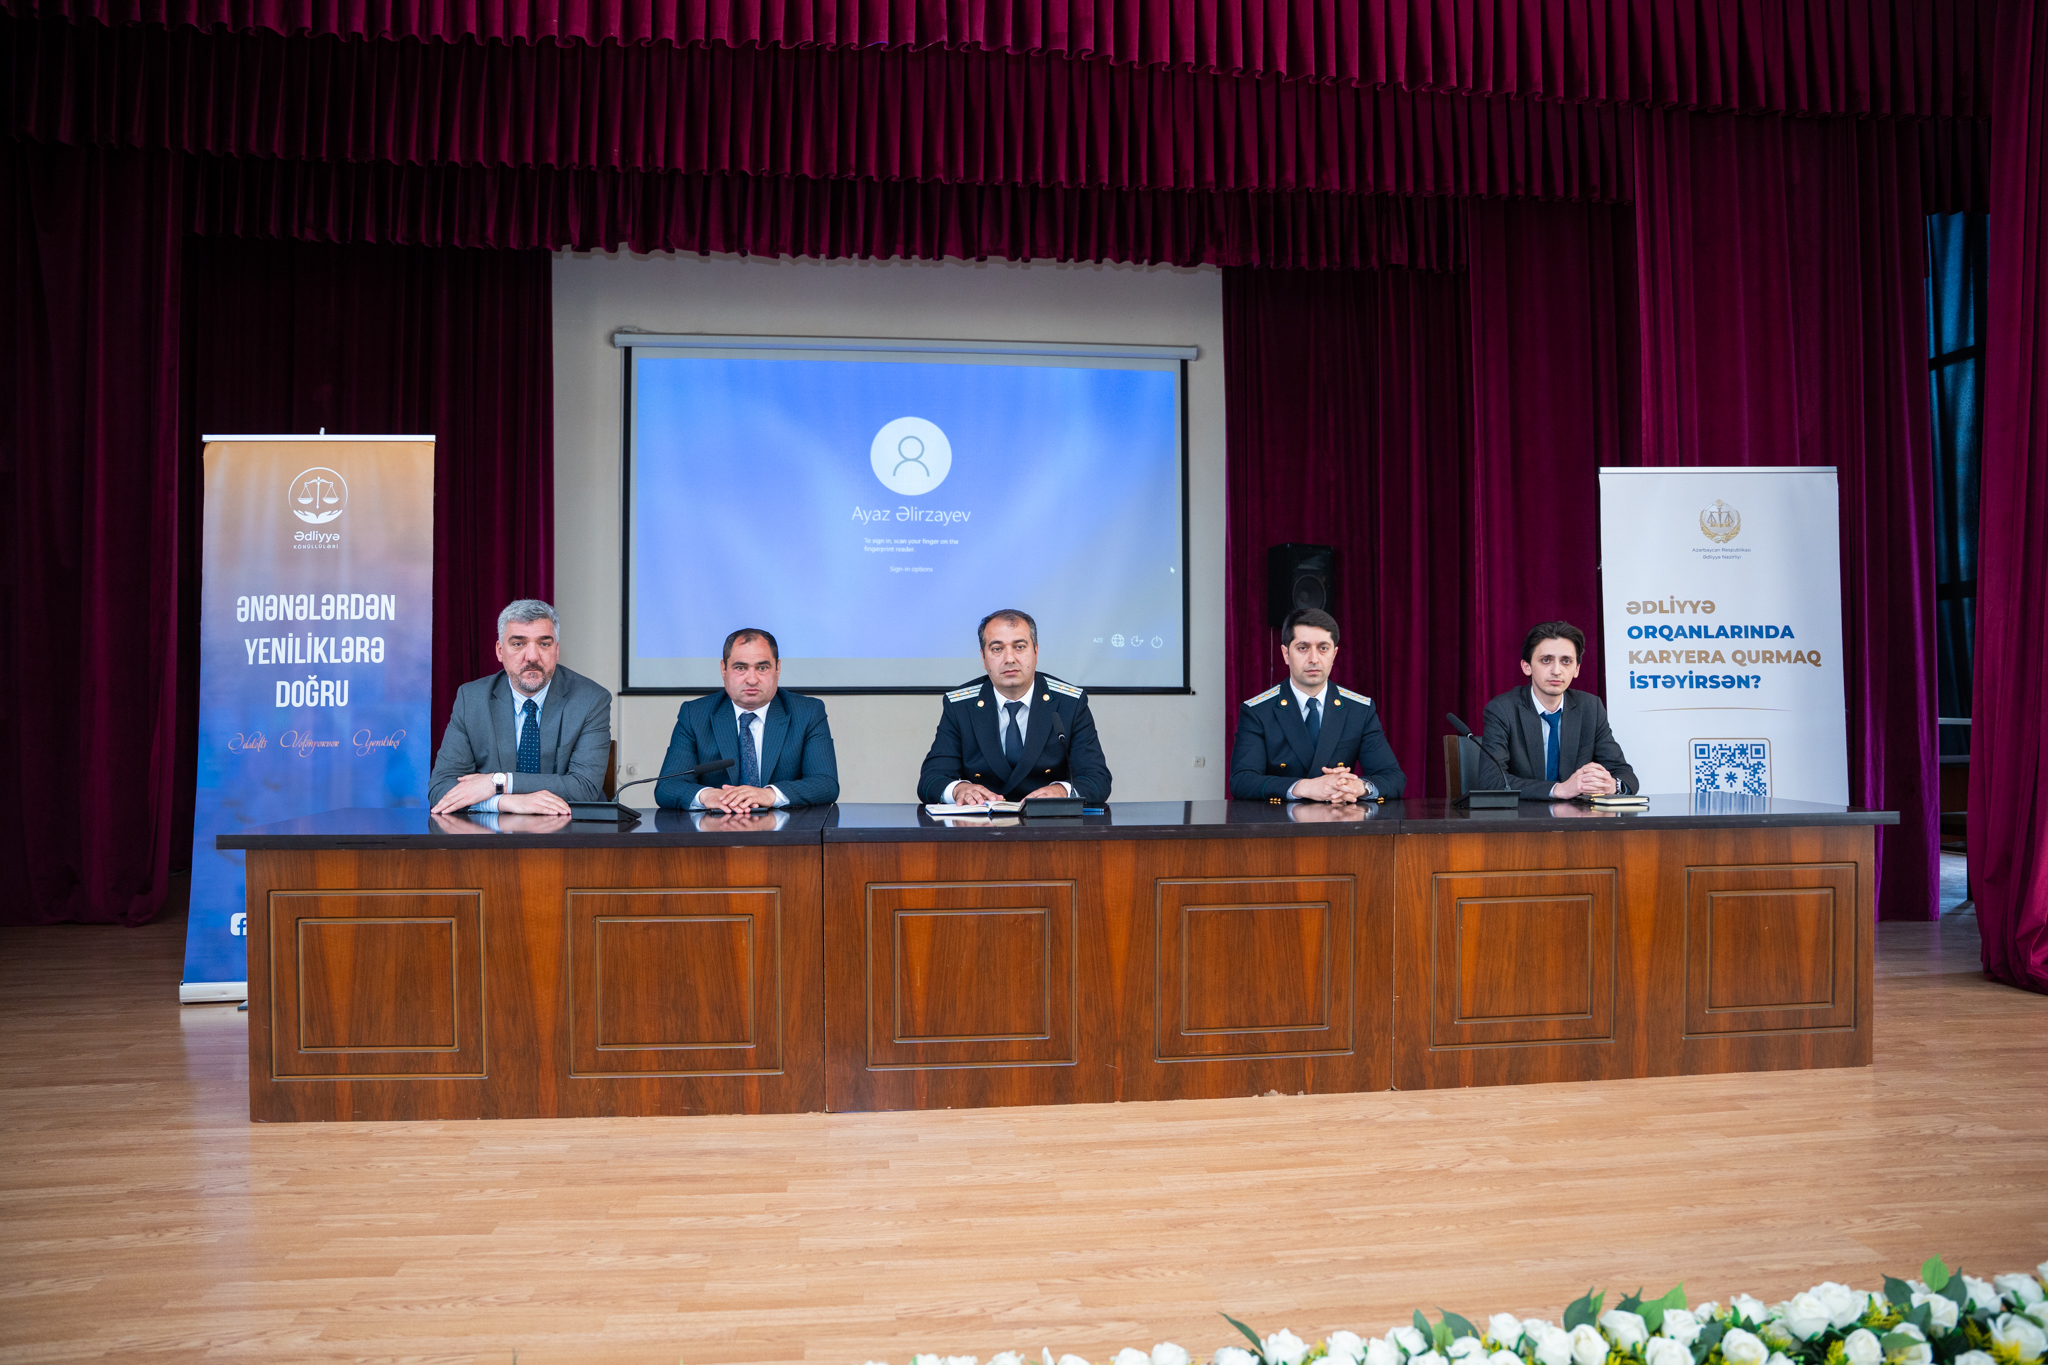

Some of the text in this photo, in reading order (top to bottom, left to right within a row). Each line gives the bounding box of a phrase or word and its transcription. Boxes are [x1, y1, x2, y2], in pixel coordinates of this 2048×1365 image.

[852, 506, 972, 526] Ayaz Əlirzayev
[294, 530, 340, 543] Ədliyyə
[922, 538, 940, 546] finger
[236, 593, 396, 622] ƏNƏNƏLƏRDƏN
[1626, 595, 1716, 614] ƏDLİYYƏ
[1627, 625, 1795, 642] ORQANLARINDA
[244, 632, 385, 665] YENİLİKLƏRƏ
[1628, 650, 1822, 667] KARYERA QURMAQ
[1630, 670, 1762, 689] İSTƏYİRSƏN?
[275, 674, 349, 708] DOĞRU
